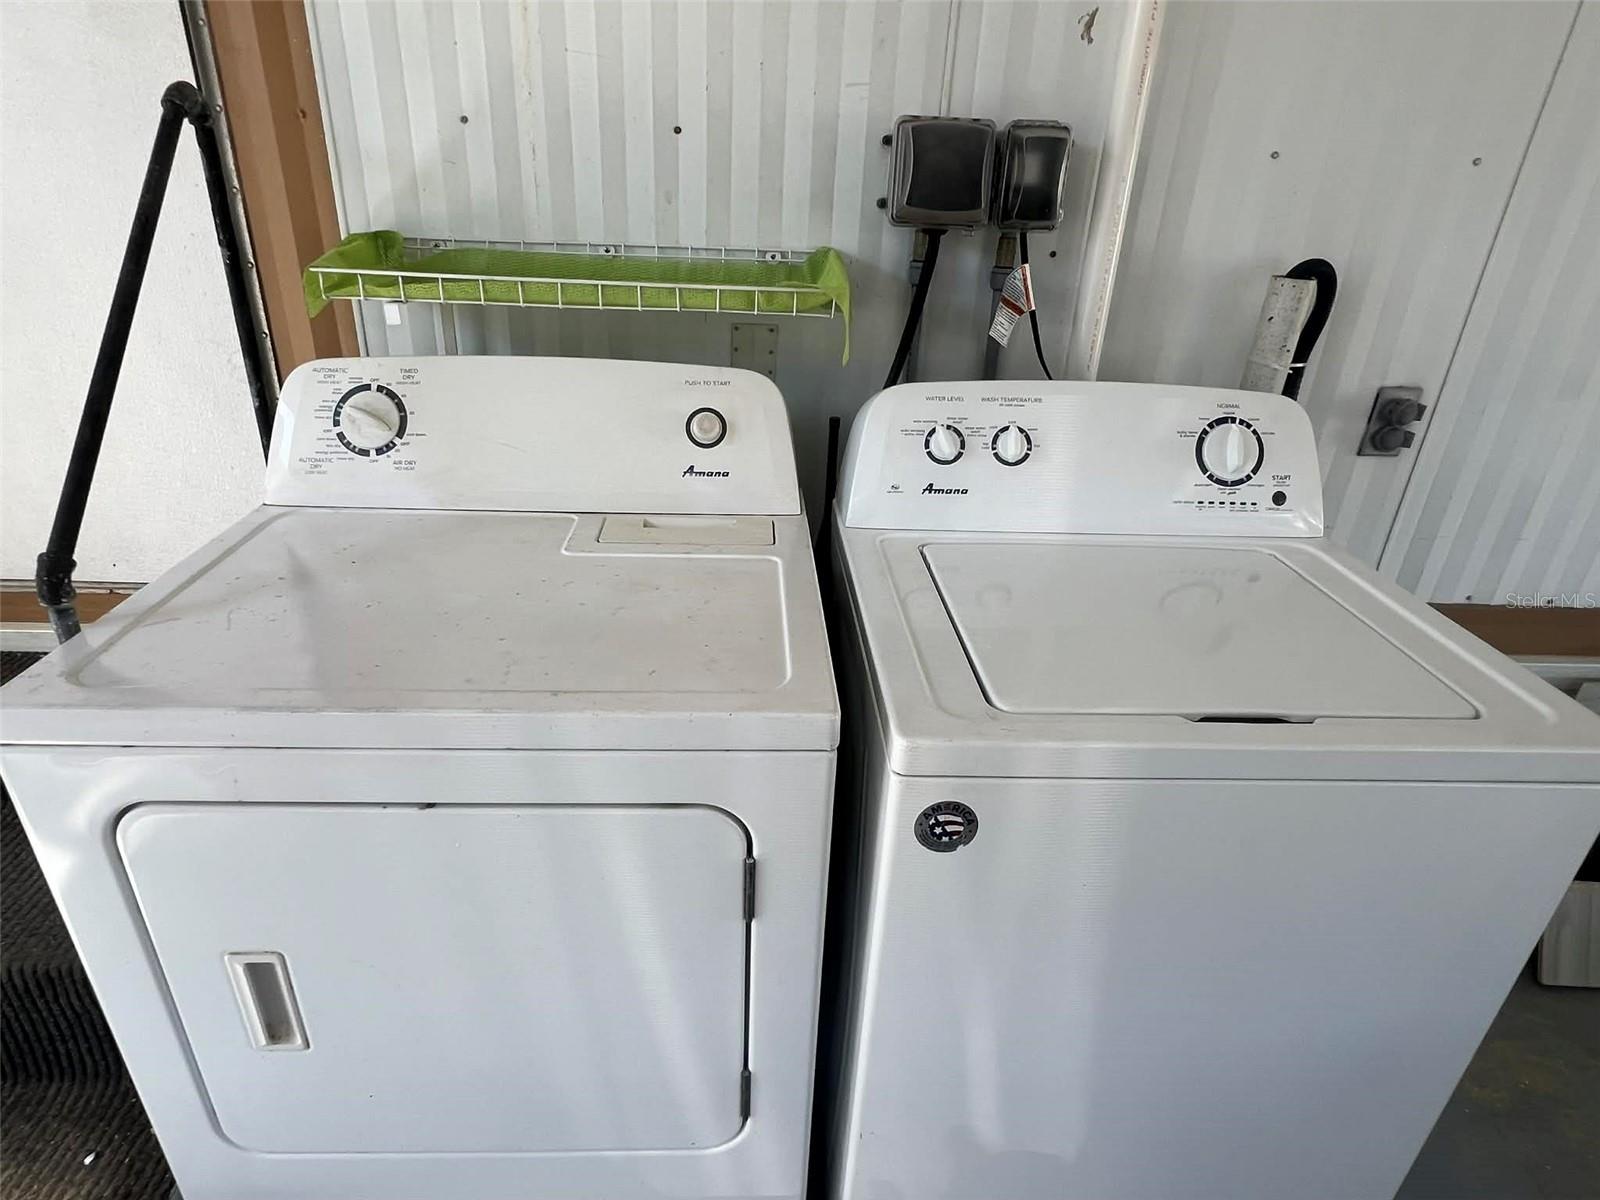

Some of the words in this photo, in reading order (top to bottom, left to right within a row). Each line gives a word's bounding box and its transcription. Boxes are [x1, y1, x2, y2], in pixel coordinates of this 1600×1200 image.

[682, 464, 730, 478] Amana
[921, 482, 969, 495] Amana
[922, 803, 976, 826] AMERICA
